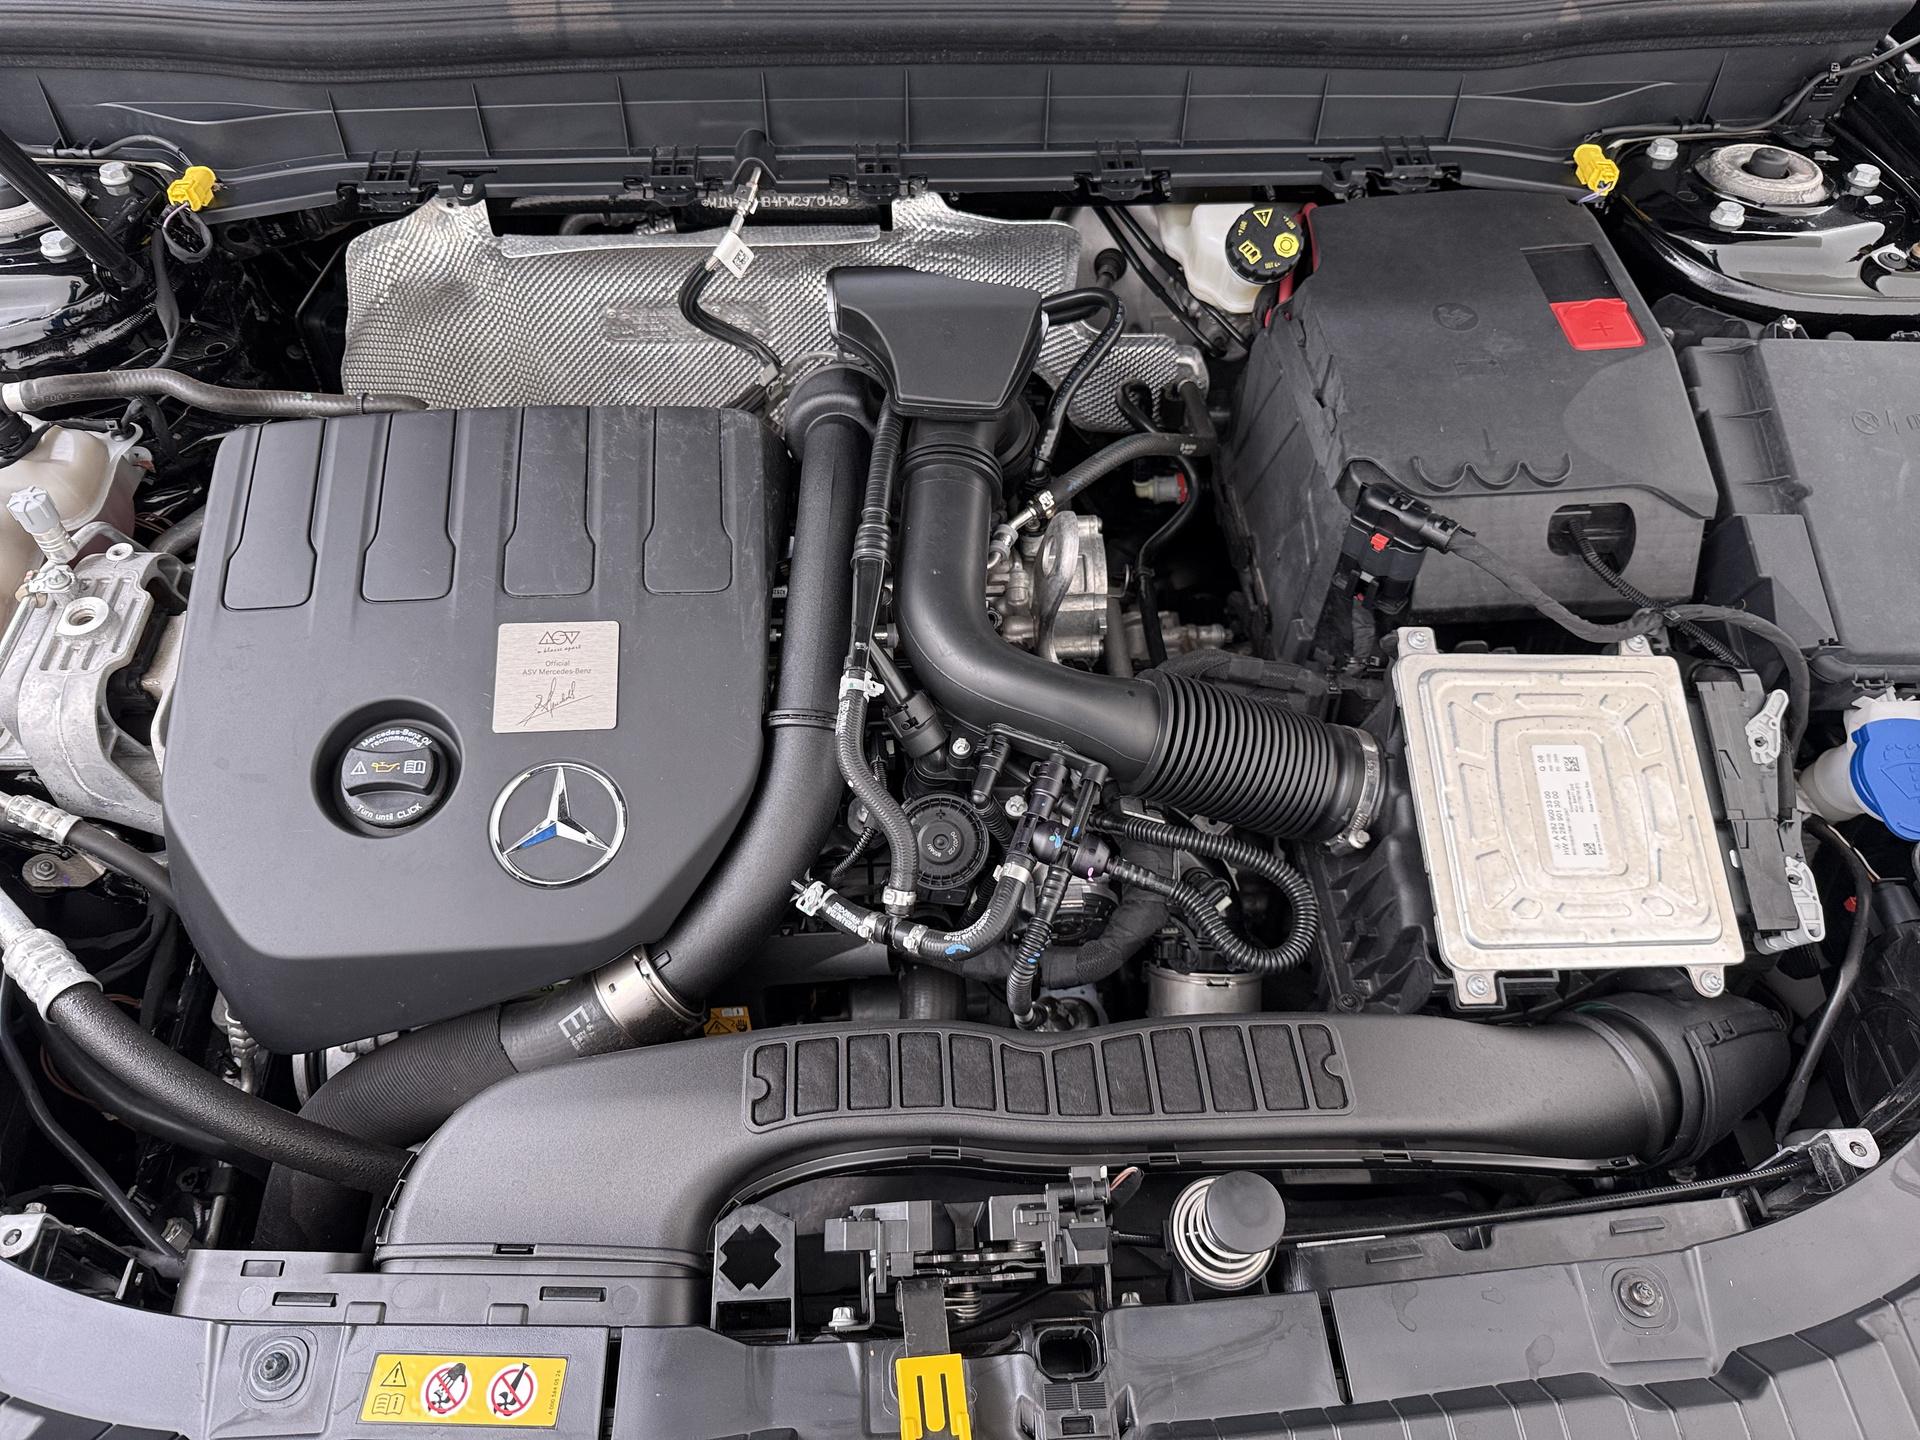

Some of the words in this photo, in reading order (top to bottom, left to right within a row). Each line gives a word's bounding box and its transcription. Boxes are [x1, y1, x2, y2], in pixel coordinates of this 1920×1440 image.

[538, 630, 581, 645] ASV
[361, 728, 422, 748] Mercedes-Benz
[422, 736, 432, 746] Oil
[356, 804, 374, 818] Turn
[376, 812, 394, 820] until
[396, 802, 422, 819] CLICK
